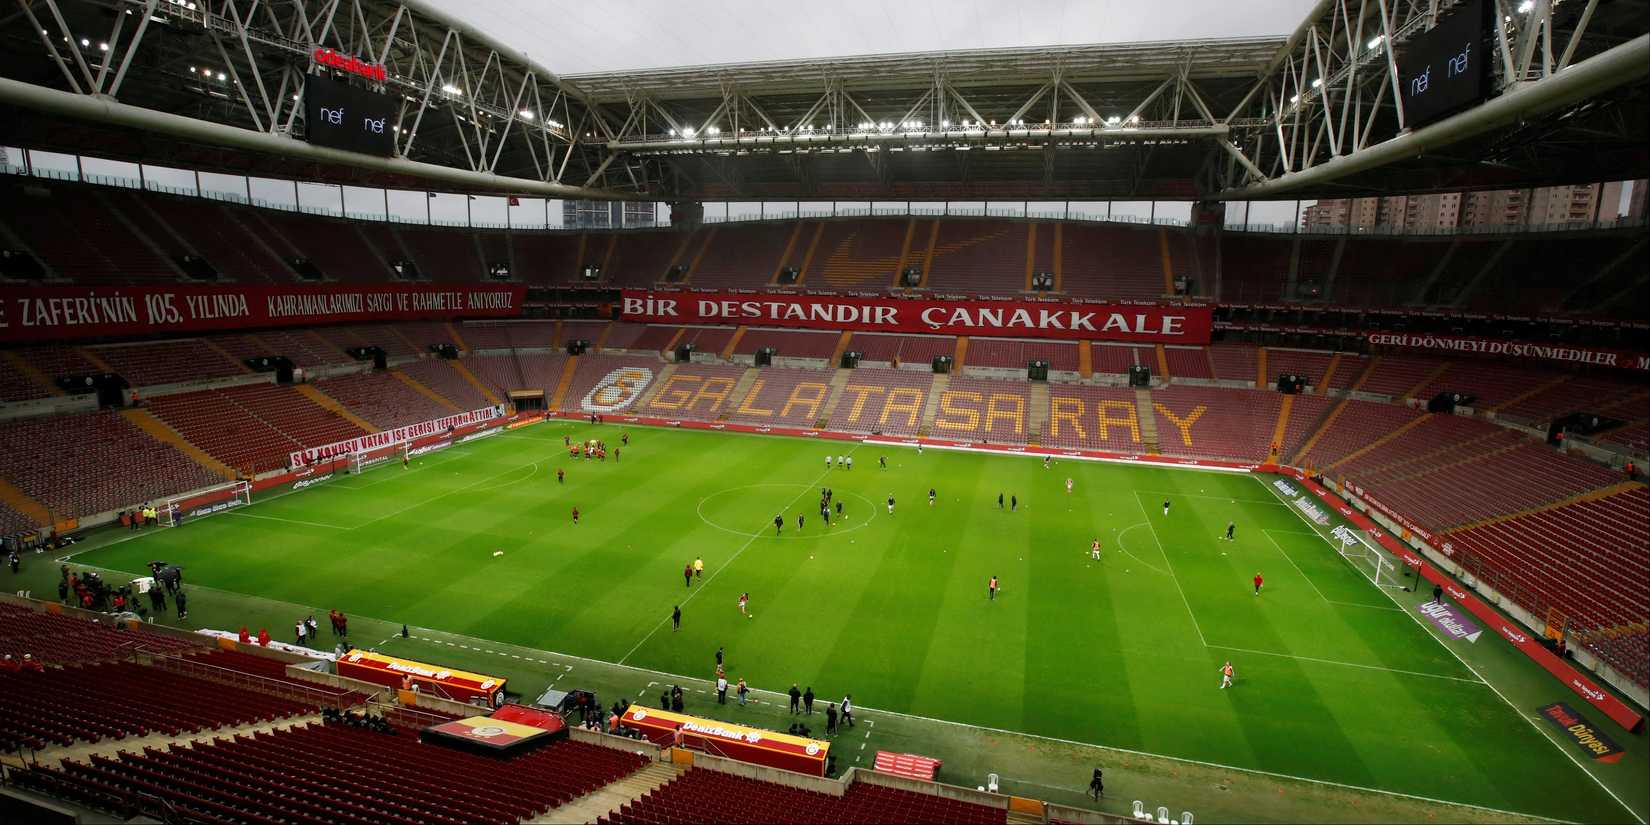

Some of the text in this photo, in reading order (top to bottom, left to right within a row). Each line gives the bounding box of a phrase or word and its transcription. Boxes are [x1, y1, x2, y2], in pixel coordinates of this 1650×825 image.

[1447, 42, 1471, 78] nef
[1411, 64, 1431, 95] nef
[320, 107, 344, 125] nef
[364, 117, 386, 134] nef
[17, 291, 137, 327] ZAFERİ'NİN
[145, 293, 183, 325] 105.
[187, 294, 250, 320] YILINDA
[267, 293, 364, 318] KAHRAMANLARIMIZI
[367, 292, 393, 313] SAYGI
[396, 292, 409, 312] VE
[412, 291, 463, 312] RAHMETLE
[468, 291, 512, 310] ANIYORUZ
[623, 295, 679, 317] BİR
[698, 300, 899, 325] DESTANDIR
[921, 307, 1187, 336] ÇANAKKALE
[1368, 333, 1407, 346] GERİ
[1410, 334, 1487, 353] DÖNMEYİ
[360, 432, 390, 450] VATAN
[408, 421, 435, 439] GERİSİ
[682, 721, 742, 741] DenizBank
[1568, 723, 1611, 755] Dünyası
